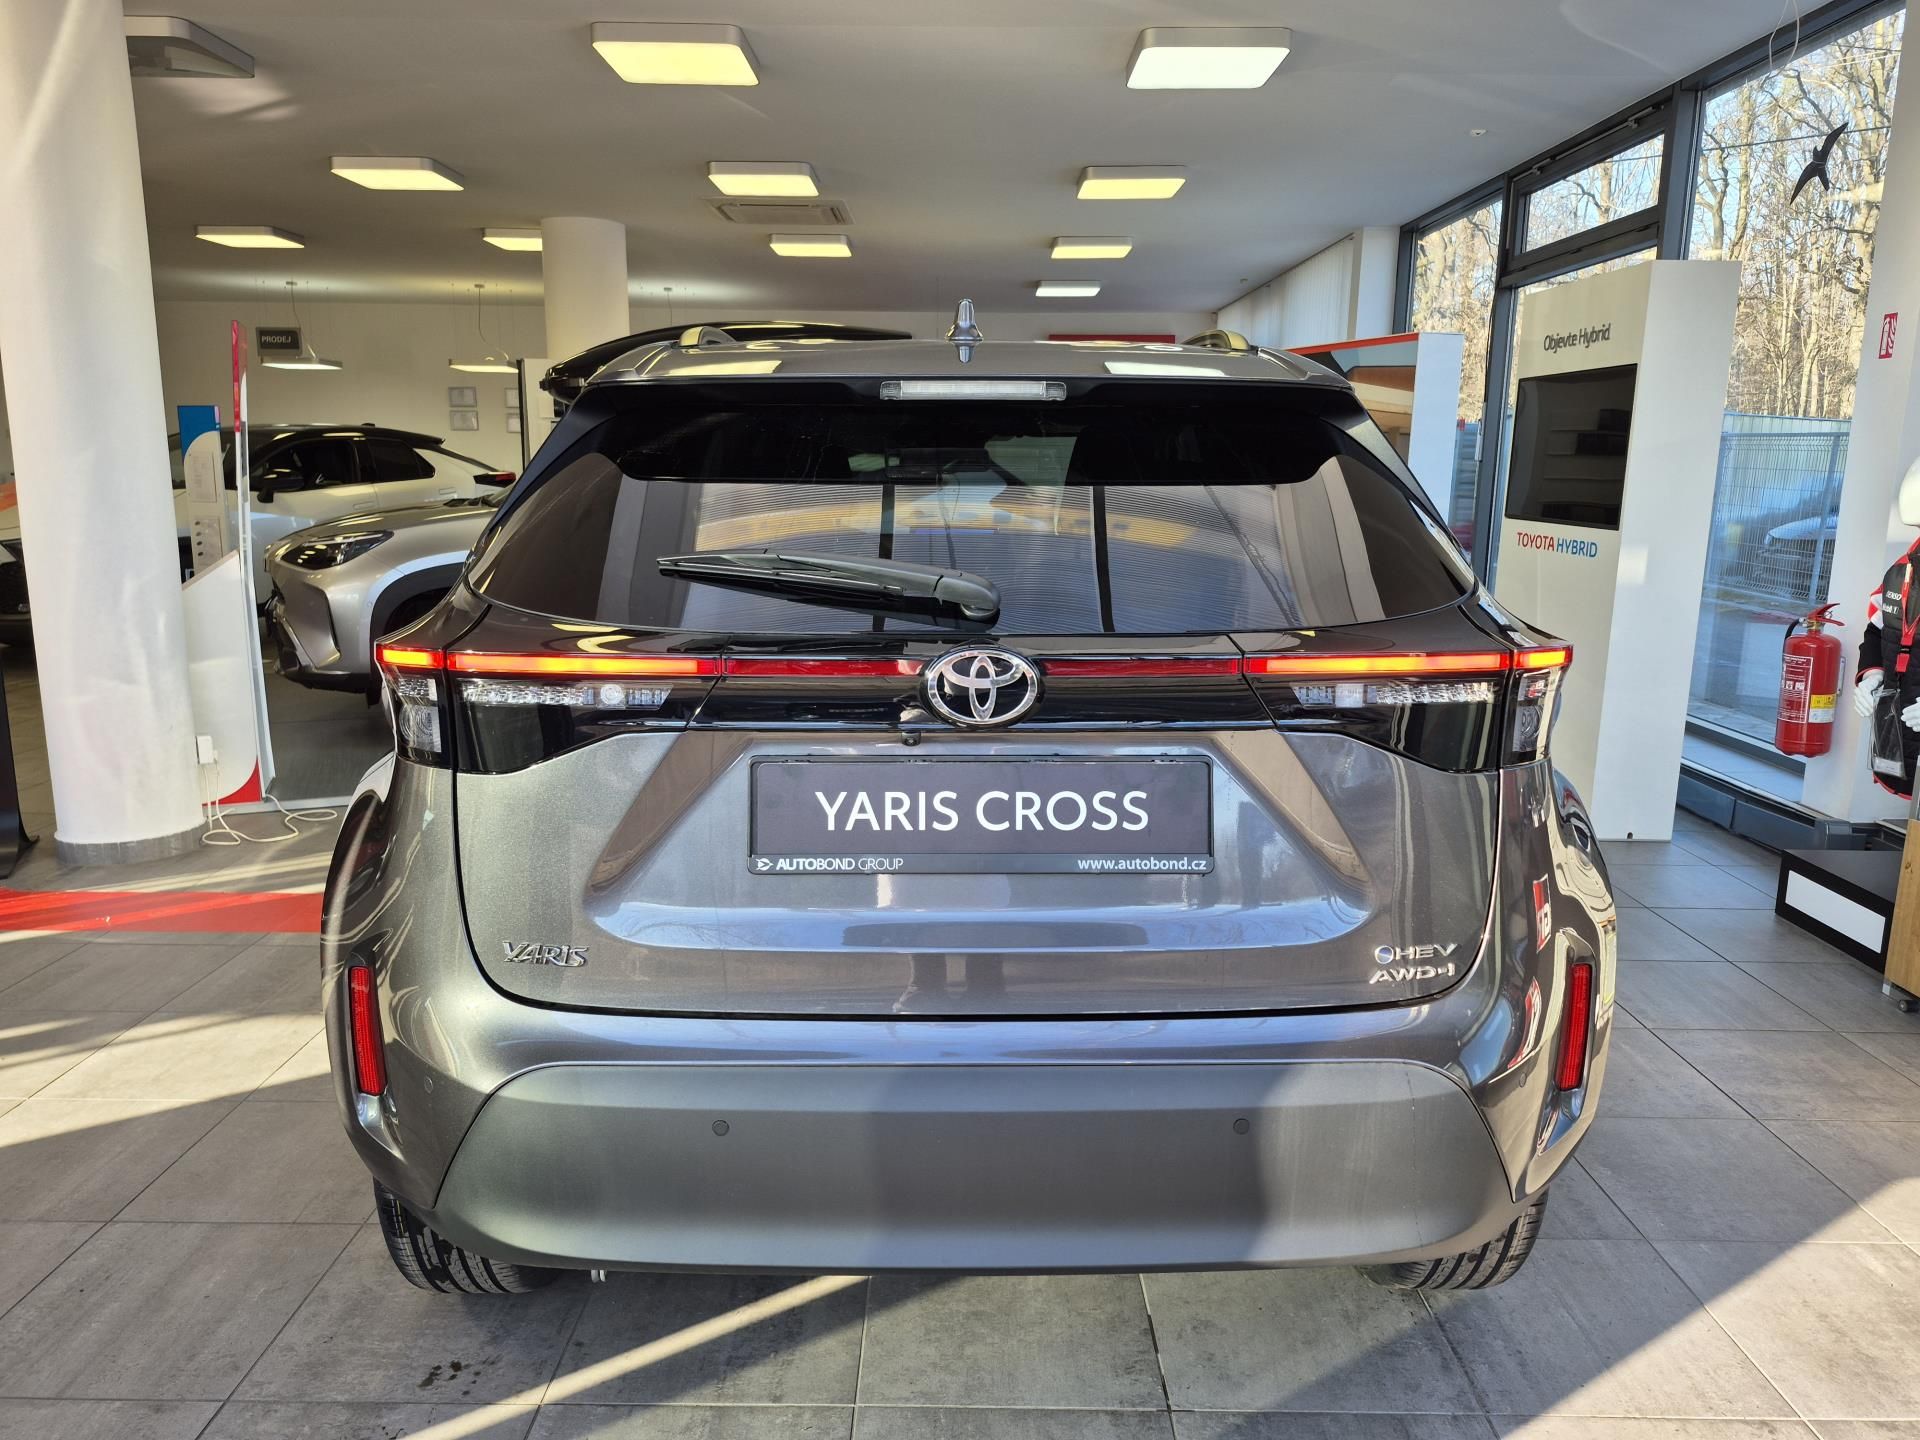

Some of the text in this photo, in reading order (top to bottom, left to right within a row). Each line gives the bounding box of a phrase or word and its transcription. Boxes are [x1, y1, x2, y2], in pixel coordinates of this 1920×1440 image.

[261, 335, 291, 343] PRODEJ
[1544, 322, 1611, 353] Objevte Hybrid
[1517, 532, 1598, 558] TOYOTA HYBRID
[814, 790, 1149, 832] YARIS CROSS
[776, 857, 904, 871] AUTOBOND GROUP
[1078, 856, 1207, 871] www.autobond.cz
[502, 940, 590, 967] YARIS
[1395, 943, 1457, 960] HEV
